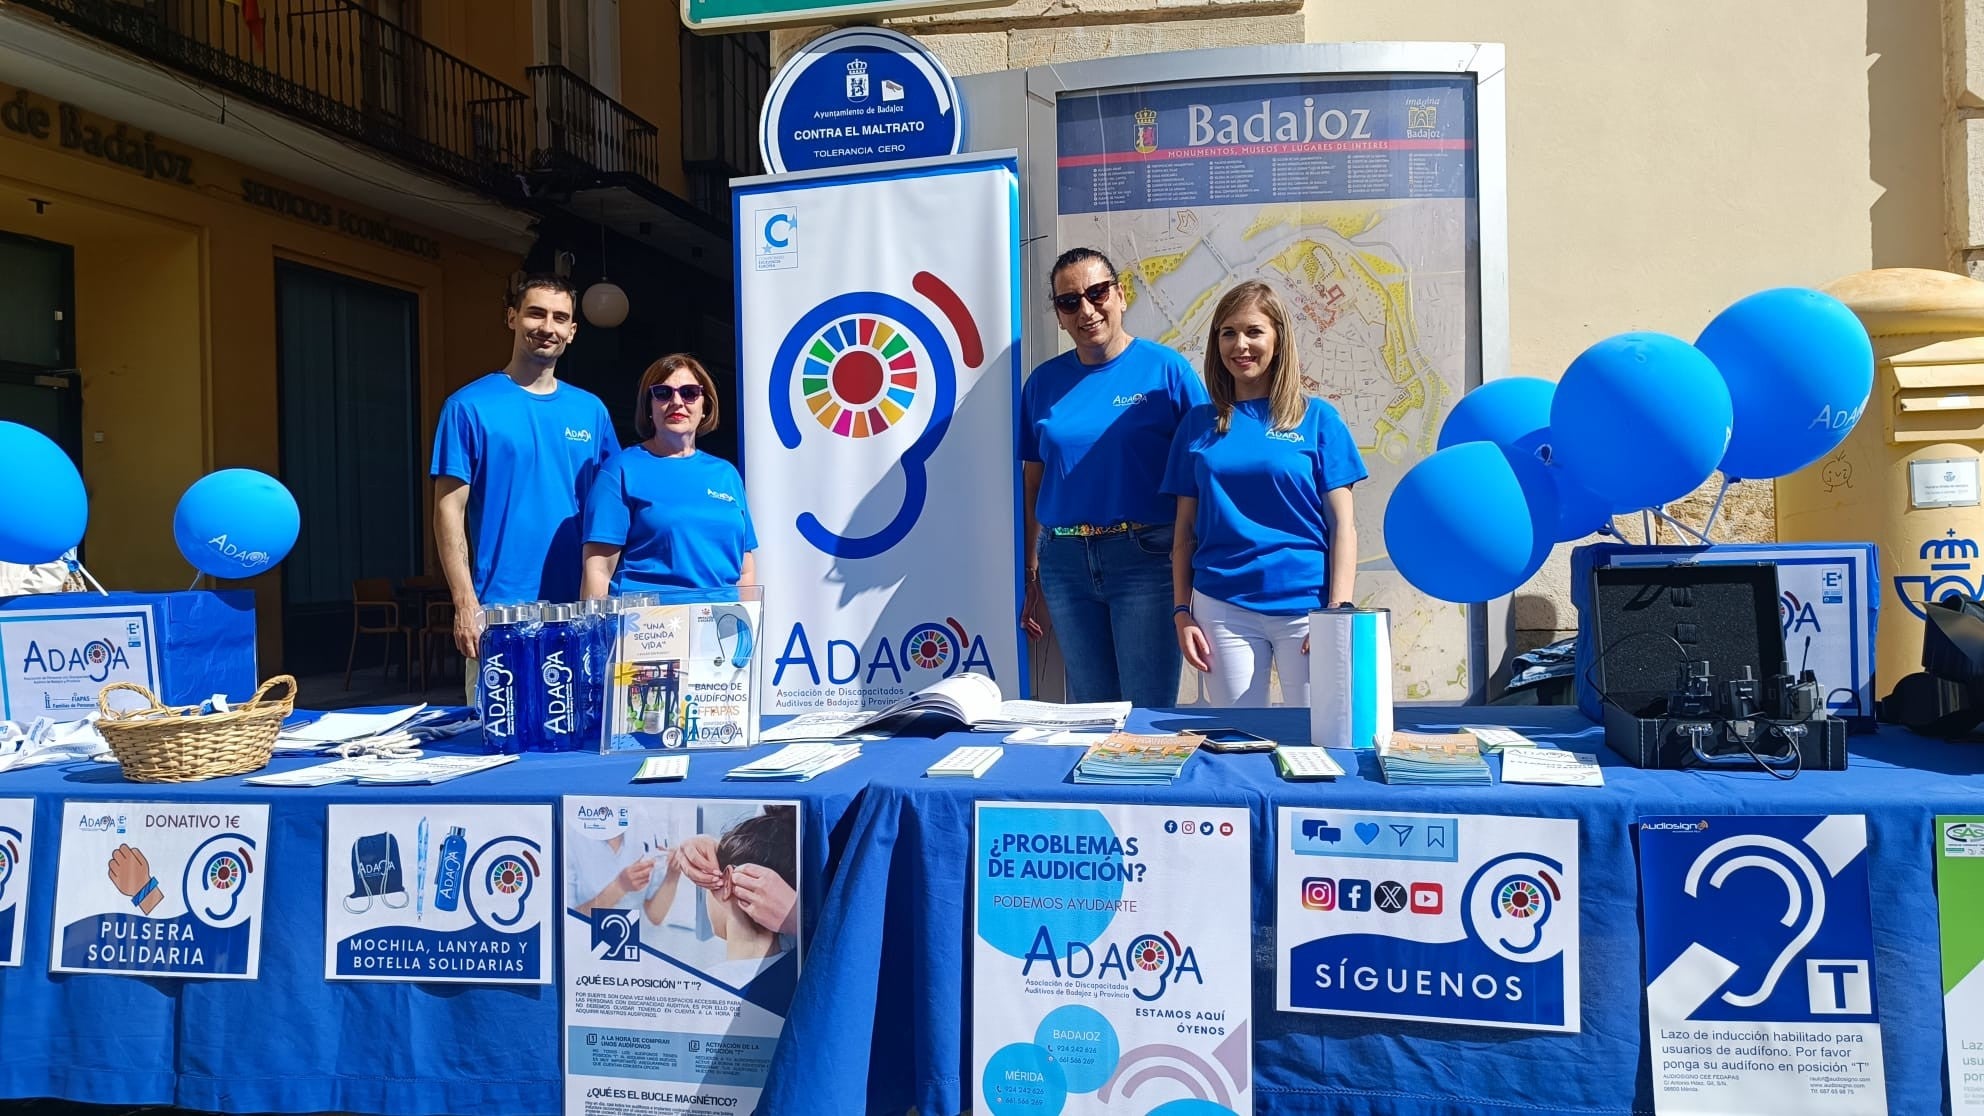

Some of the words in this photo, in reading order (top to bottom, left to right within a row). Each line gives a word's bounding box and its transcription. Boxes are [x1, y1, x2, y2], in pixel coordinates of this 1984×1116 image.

[813, 107, 865, 120] Ayuntamiento
[866, 106, 875, 115] de
[877, 104, 904, 114] Badajoz
[1188, 96, 1372, 147] Badajoz
[1, 89, 50, 139] de
[58, 101, 195, 185] Badajoz
[793, 127, 843, 141] CONTRA
[845, 126, 860, 137] EL
[861, 120, 925, 136] MALTRATO
[1406, 128, 1441, 140] Badajoz
[813, 145, 874, 159] TOLERANCIA
[877, 143, 906, 154] CERO
[1168, 147, 1238, 159] MONUMENTOS,
[1241, 144, 1278, 154] MUSEOS
[1282, 143, 1289, 153] Y
[1292, 141, 1333, 152] LUGARES
[1336, 141, 1349, 151] DE
[634, 630, 674, 641] SEGUNDA
[694, 682, 729, 692] BANCO
[730, 682, 743, 691] DE
[776, 687, 823, 698] Asociación
[824, 688, 836, 697] de
[838, 686, 904, 698] Discapacitados
[693, 692, 748, 703] AUDÍFONOS
[775, 698, 813, 708] Auditivos
[814, 698, 825, 707] de
[826, 697, 859, 708] Badajoz
[860, 698, 867, 708] y
[868, 697, 901, 706] Provinc
[145, 814, 221, 829] DONATIVO
[224, 814, 241, 829] 1€
[989, 833, 1139, 858] ¿PROBLEMAS
[988, 858, 1015, 879] DE
[1020, 856, 1147, 883] AUDICIÓN?
[993, 895, 1064, 910] PODEMOS
[1067, 897, 1137, 913] AYUDARTE
[101, 921, 195, 942] PULSERA
[350, 938, 431, 954] MOCHILA,
[438, 940, 511, 954] LANYARD
[518, 941, 528, 954] Y
[626, 946, 636, 958] T
[87, 944, 205, 966] SOLIDARIA
[353, 956, 422, 970] BOTELLA
[428, 957, 525, 972] SOLIDARIAS
[575, 974, 602, 986] ¿QUÉ
[602, 976, 616, 986] ES
[616, 977, 630, 987] LA
[630, 978, 676, 990] POSICIÓN
[1025, 978, 1063, 988] Asociación
[1064, 980, 1074, 988] de
[1075, 980, 1129, 991] Discapacitados
[1314, 958, 1524, 1002] SÍGUENOS
[1817, 964, 1859, 1009] T
[1024, 987, 1055, 995] Auditivos
[1056, 988, 1065, 996] de
[1066, 988, 1092, 997] Badajoz
[1099, 989, 1130, 999] Provincia
[1135, 1008, 1192, 1020] ESTAMOS
[1195, 1008, 1226, 1022] AQUÍ
[1053, 1029, 1101, 1042] BADAJOZ
[1176, 1021, 1226, 1036] ÓYENOS
[1660, 1029, 1690, 1040] Lazo
[1693, 1030, 1709, 1040] de
[1712, 1030, 1769, 1041] inducción
[1773, 1031, 1832, 1042] habilitado
[1835, 1033, 1864, 1045] para
[1961, 1039, 1984, 1050] Laz
[1661, 1044, 1712, 1055] usuarios
[1716, 1045, 1731, 1055] de
[1735, 1046, 1791, 1057] audífono.
[1796, 1046, 1817, 1057] Por
[1820, 1047, 1851, 1057] favor
[1662, 1060, 1699, 1072] ponga
[1703, 1061, 1718, 1070] su
[1721, 1060, 1775, 1071] audífono
[1778, 1062, 1793, 1072] en
[1797, 1061, 1848, 1074] posición
[1005, 1069, 1044, 1082] MÉRIDA
[586, 1086, 612, 1098] ¿QUÉ
[613, 1089, 626, 1098] ES
[627, 1090, 640, 1100] EL
[641, 1091, 673, 1103] BUCLE
[674, 1093, 738, 1107] MAGNÉTICO?
